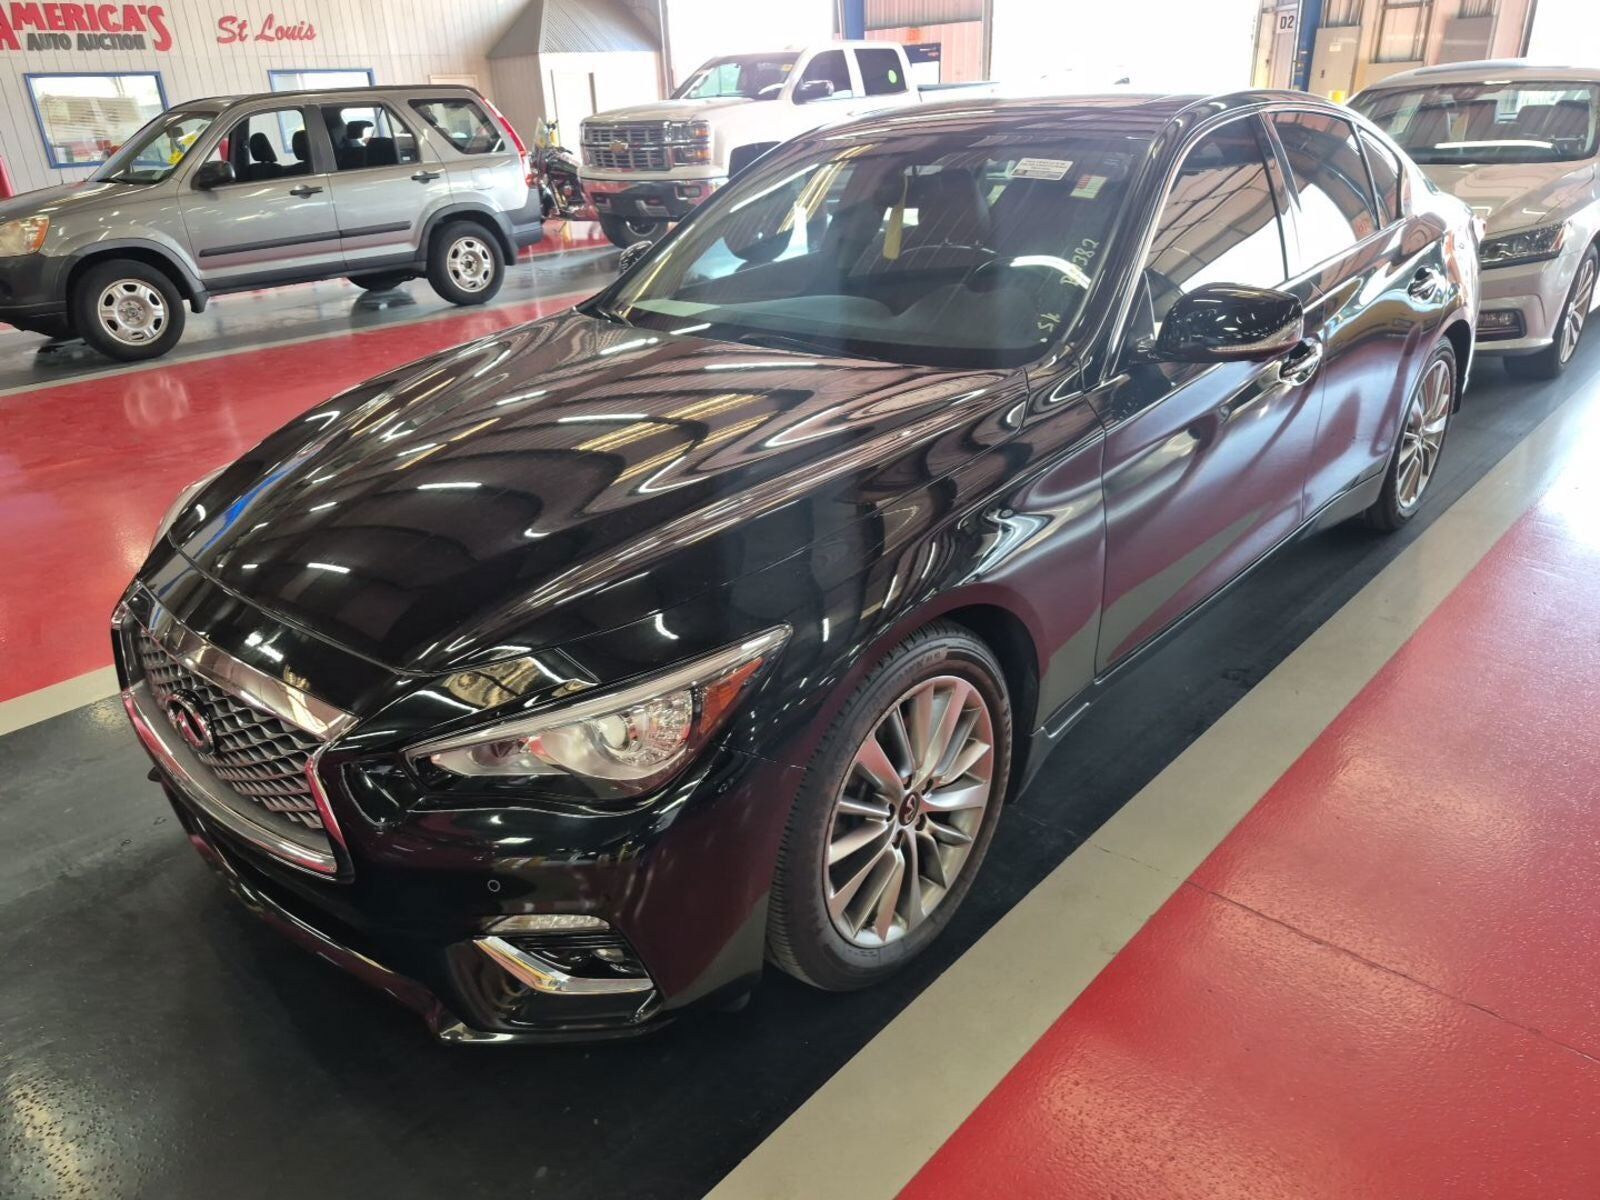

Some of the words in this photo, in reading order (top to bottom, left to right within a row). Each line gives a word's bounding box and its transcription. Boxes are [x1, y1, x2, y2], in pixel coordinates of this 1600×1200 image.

[0, 2, 172, 51] AMERICA'S
[216, 15, 248, 44] St
[254, 13, 316, 42] Louis
[1279, 15, 1295, 30] D2
[27, 33, 72, 51] AUTO
[77, 33, 147, 51] AUCTION
